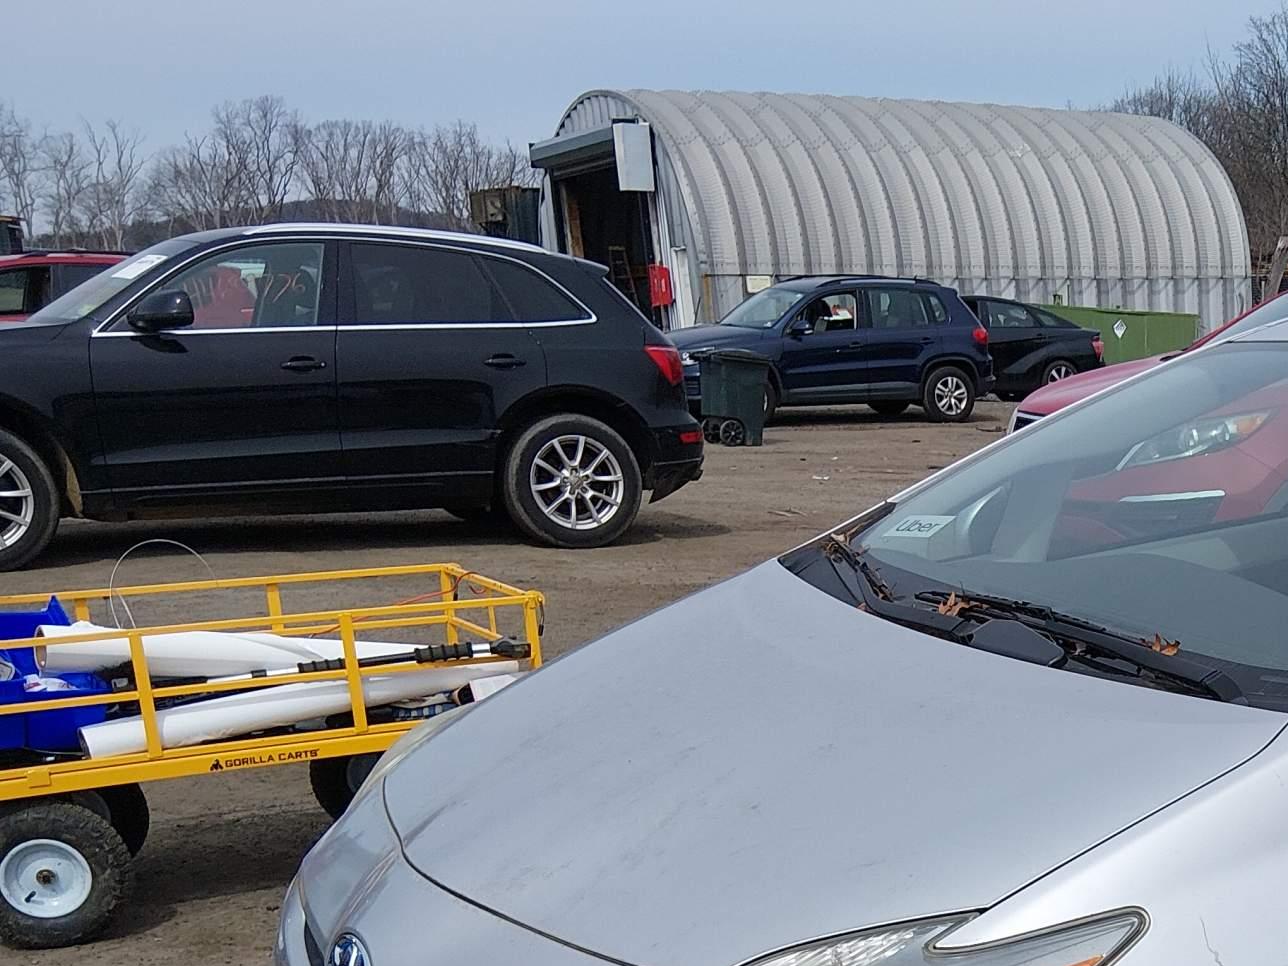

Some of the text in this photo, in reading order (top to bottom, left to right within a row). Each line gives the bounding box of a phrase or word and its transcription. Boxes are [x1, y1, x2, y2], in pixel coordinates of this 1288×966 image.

[895, 519, 943, 532] Uber
[225, 749, 318, 768] GORILLA CARTS
